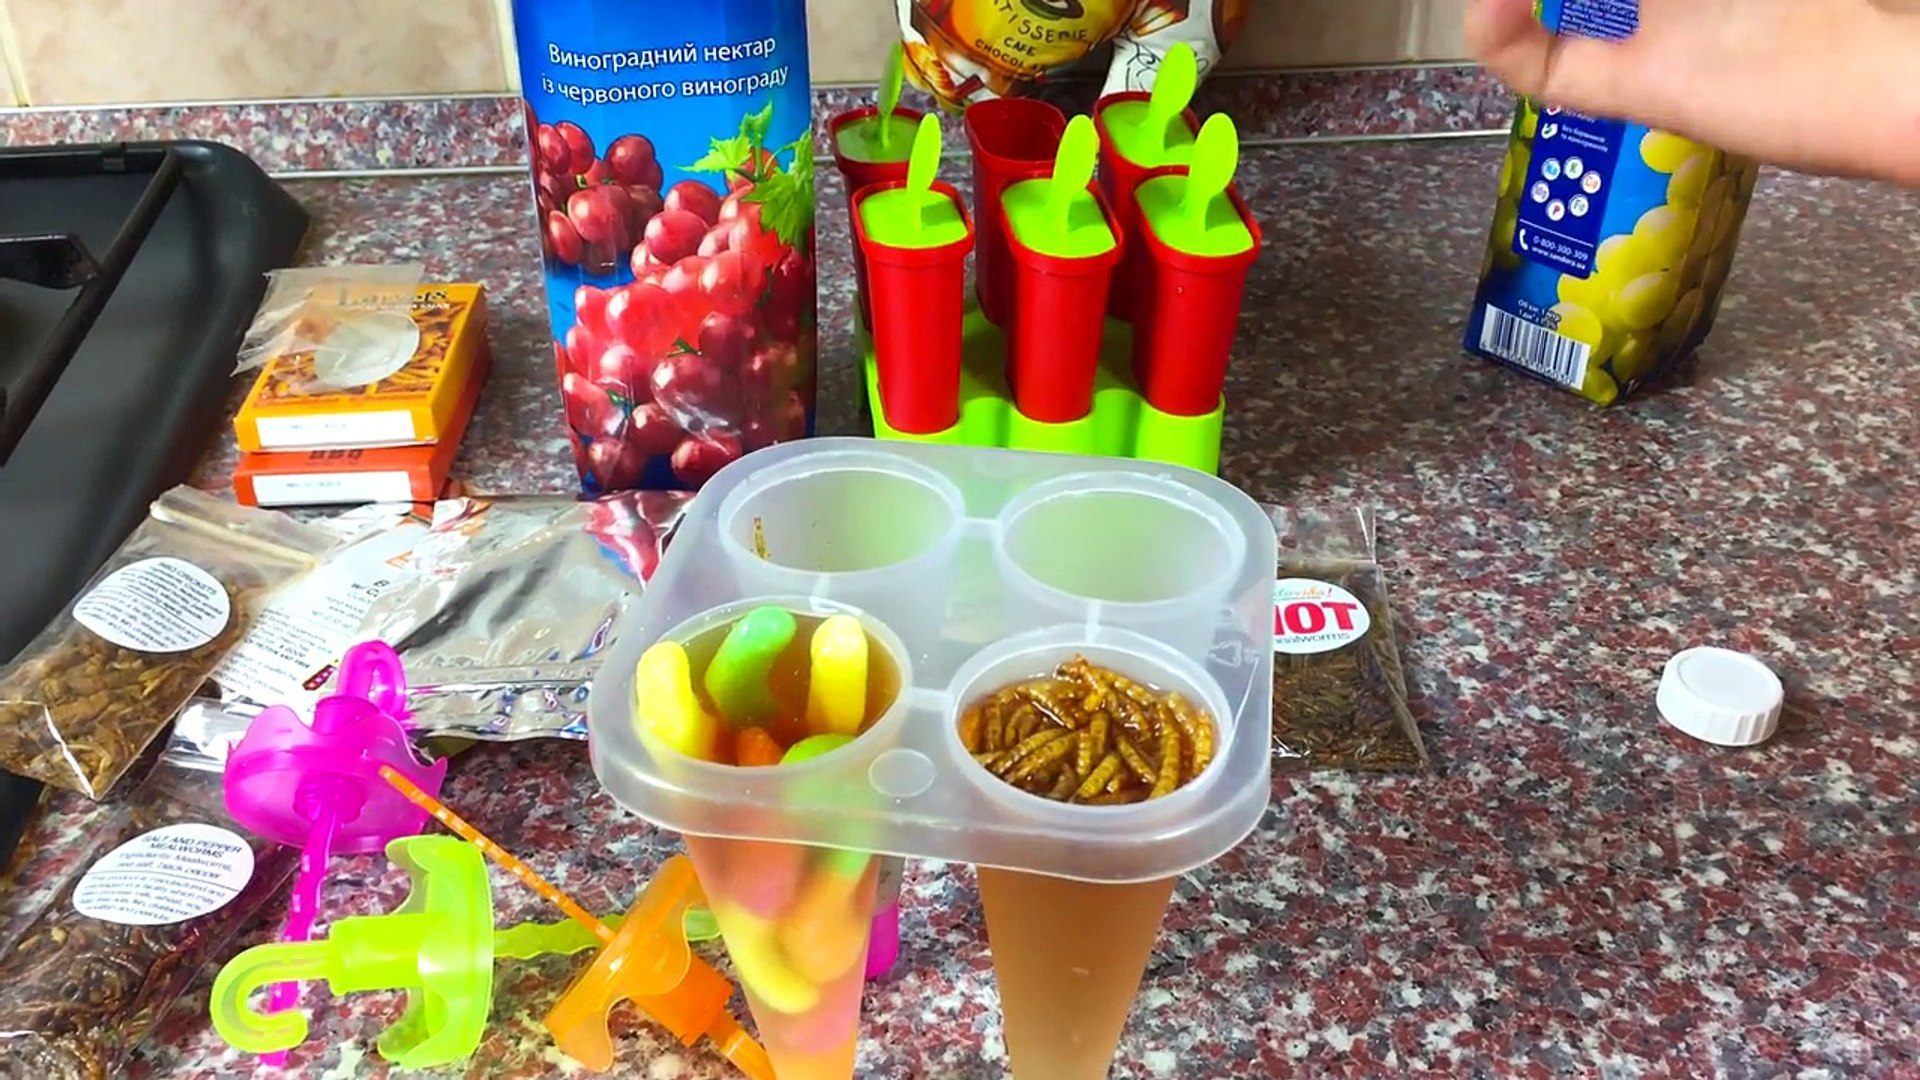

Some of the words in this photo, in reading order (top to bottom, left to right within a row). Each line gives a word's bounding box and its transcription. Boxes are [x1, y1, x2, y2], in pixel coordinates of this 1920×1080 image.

[993, 0, 1088, 43] TISSERIE
[548, 42, 698, 73] Виноградний
[703, 37, 776, 61] нектар
[1003, 36, 1038, 57] CAFE
[541, 72, 555, 94] із
[558, 80, 676, 107] червоного
[681, 65, 790, 98] винограду
[150, 842, 224, 859] MEALWORMS
[169, 836, 195, 845] AND
[196, 839, 243, 854] PEPPER
